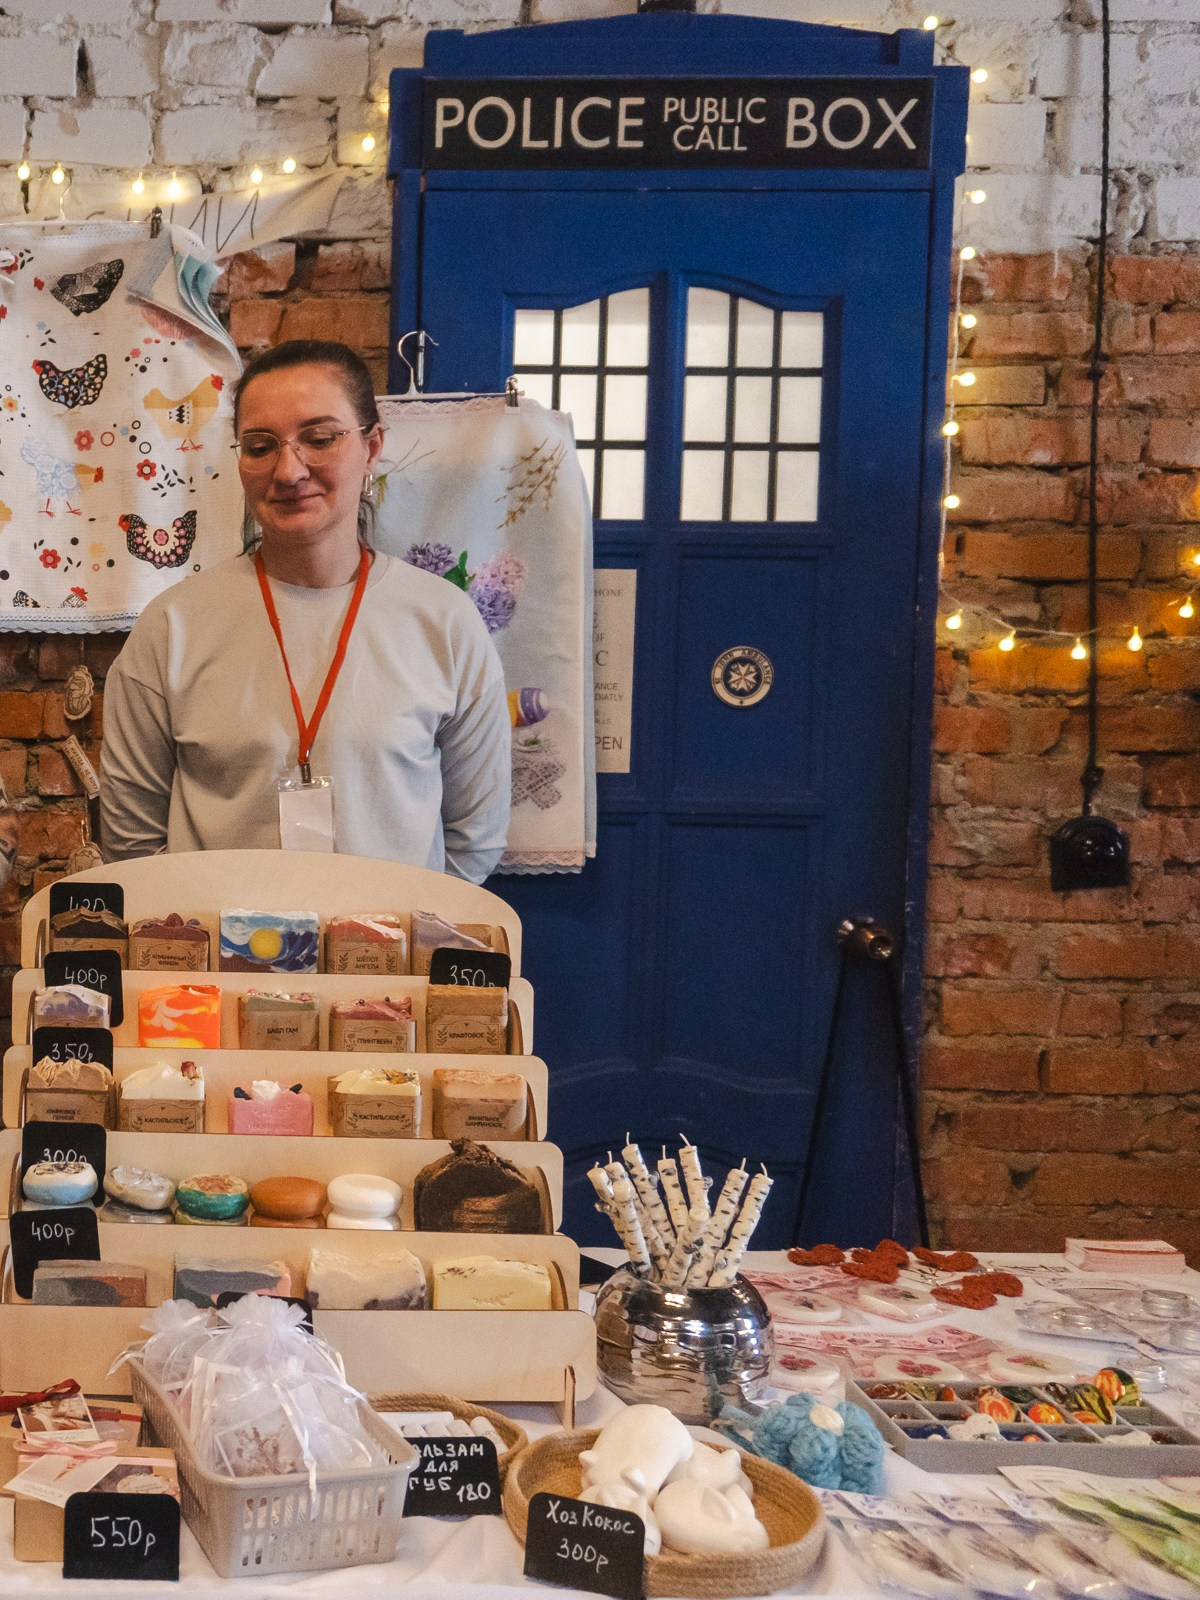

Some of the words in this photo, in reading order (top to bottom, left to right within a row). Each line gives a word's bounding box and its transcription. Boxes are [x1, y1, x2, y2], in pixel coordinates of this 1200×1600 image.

[434, 96, 645, 150] POLICE
[663, 97, 766, 124] PUBLIC
[785, 97, 918, 150] BOX
[673, 125, 748, 152] CALL
[412, 1443, 484, 1458] АЛЬЗАМ
[424, 1460, 459, 1473] ДЛЯ
[409, 1476, 452, 1492] ГУБ
[456, 1481, 492, 1503] 180
[90, 1516, 156, 1556] 550р
